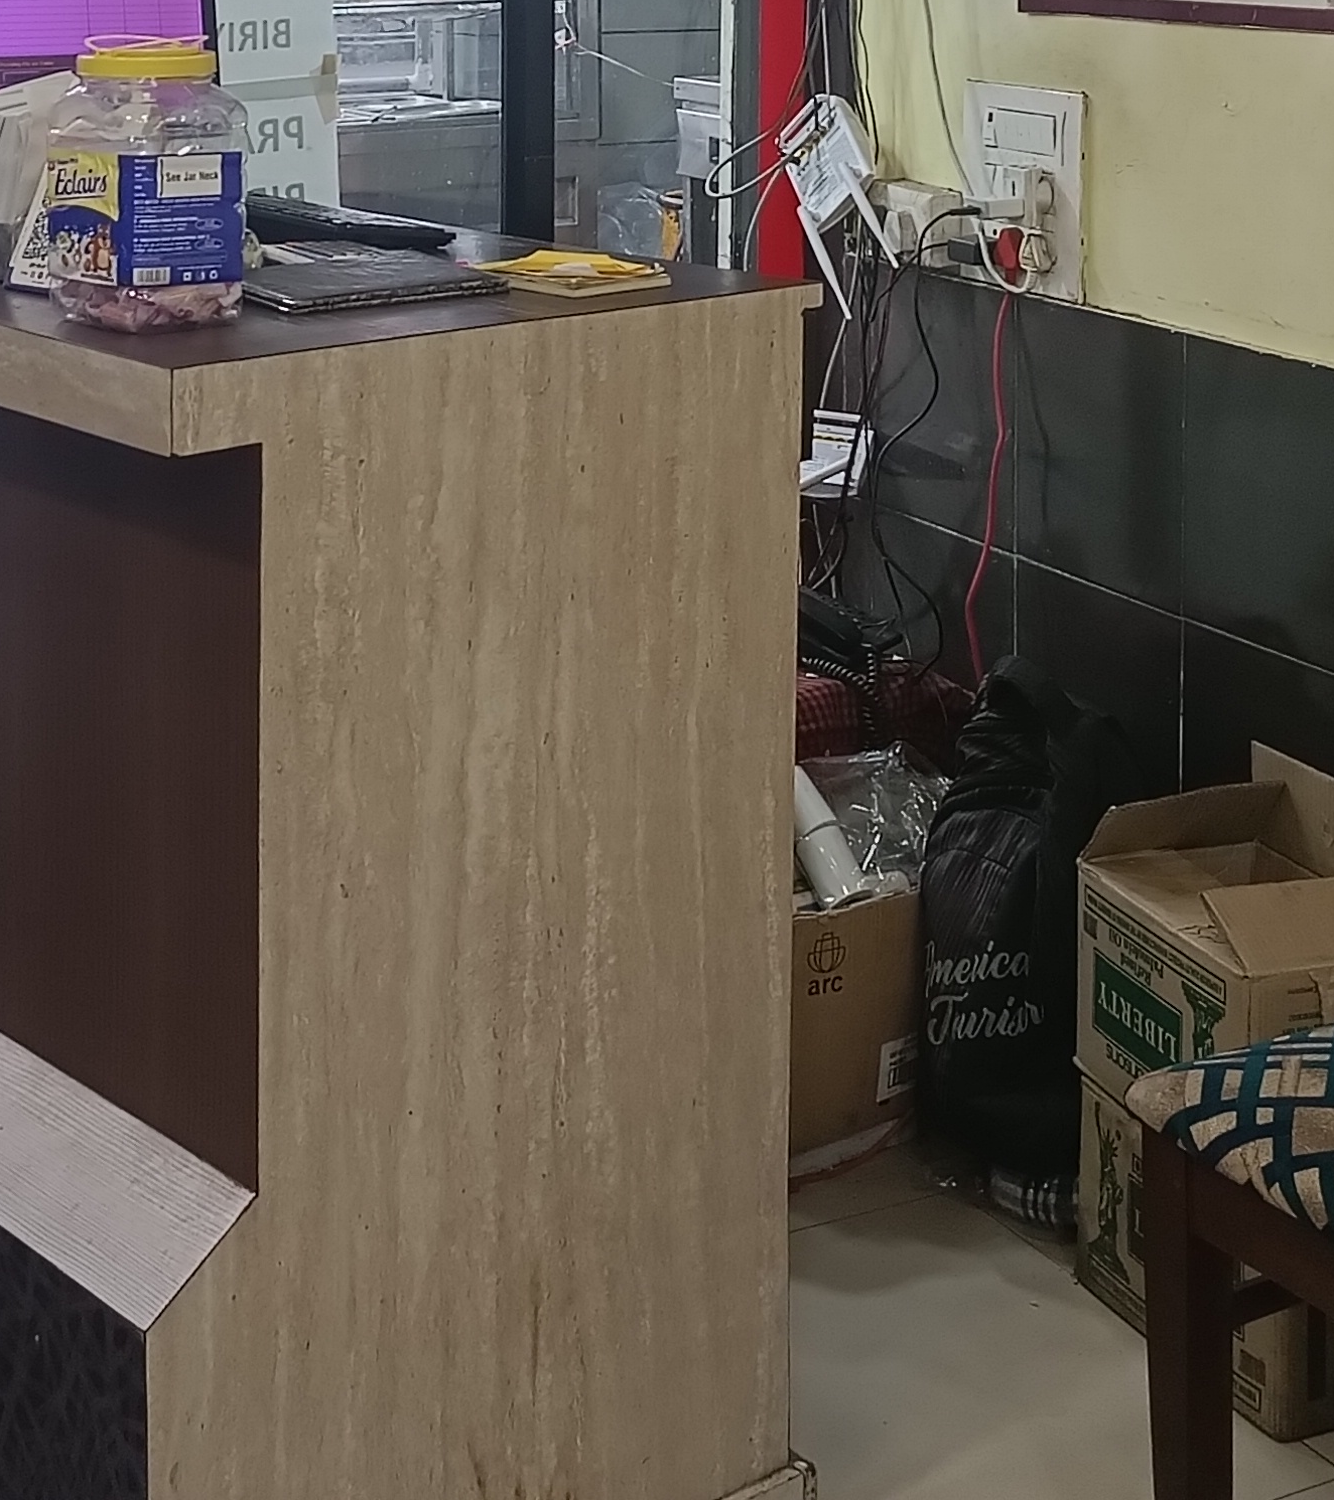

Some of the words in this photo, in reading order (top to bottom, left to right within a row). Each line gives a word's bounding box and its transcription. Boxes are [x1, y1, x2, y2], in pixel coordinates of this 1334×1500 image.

[54, 167, 108, 196] Eclairs
[807, 975, 843, 997] arc
[1098, 981, 1177, 1064] LIBERTY
